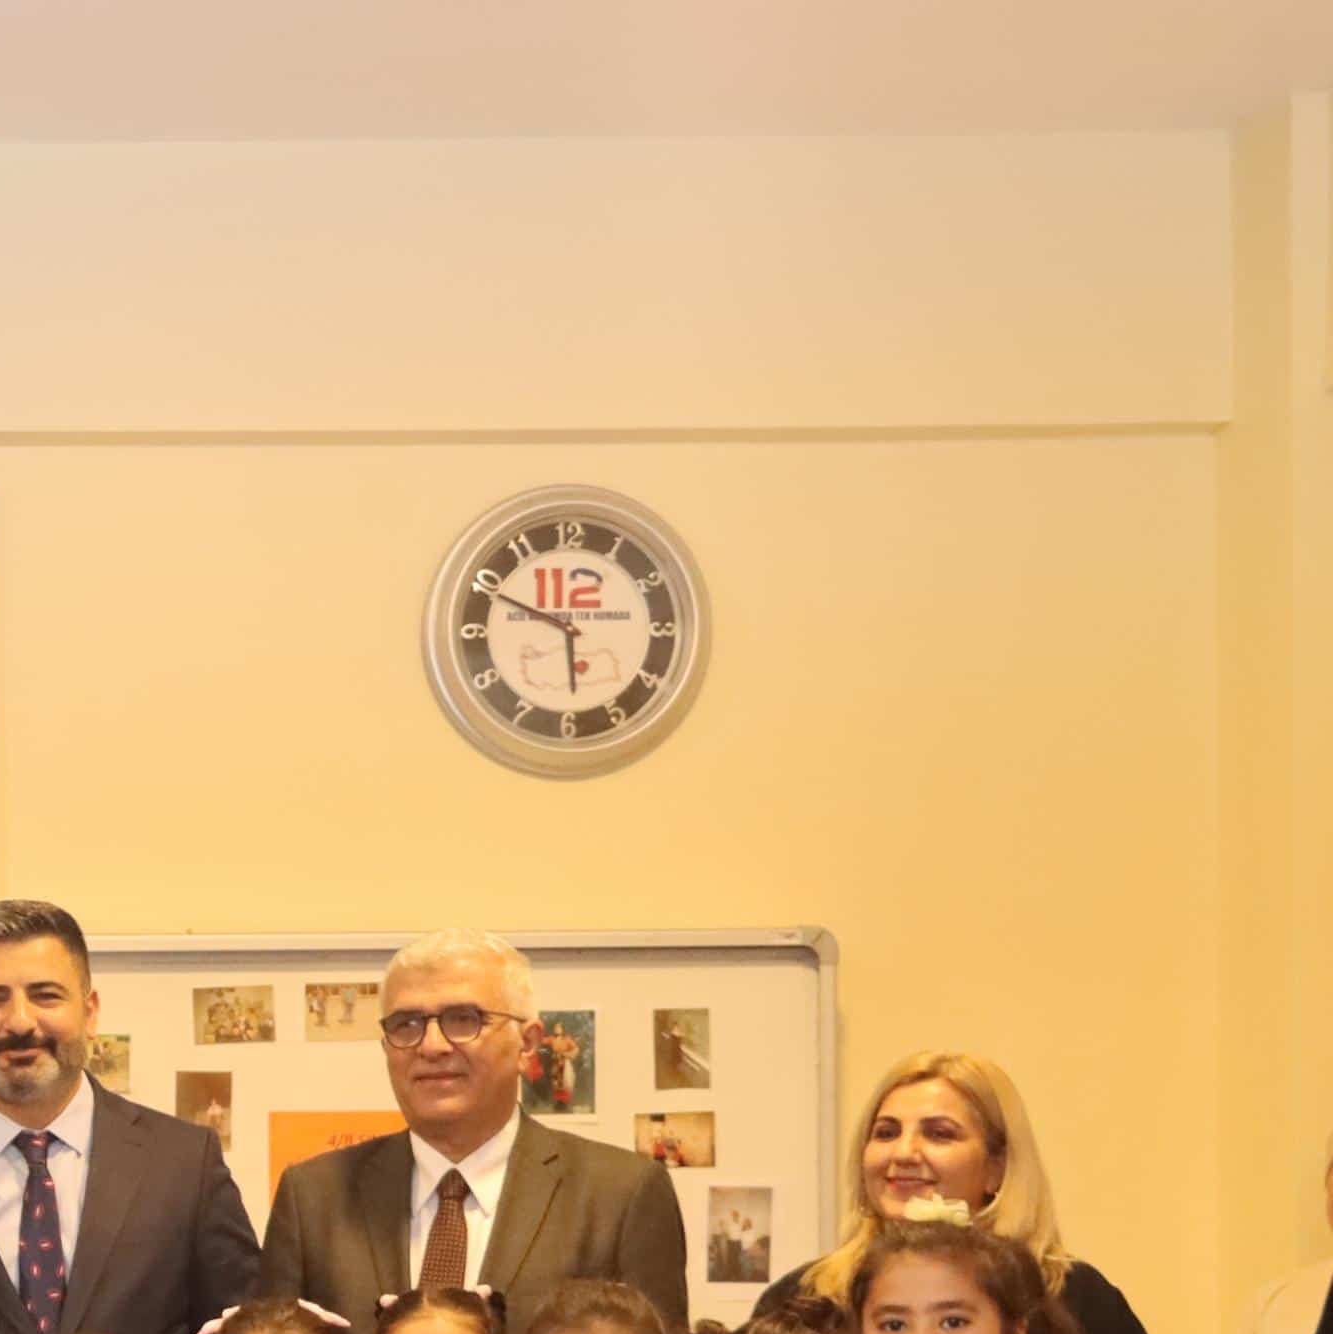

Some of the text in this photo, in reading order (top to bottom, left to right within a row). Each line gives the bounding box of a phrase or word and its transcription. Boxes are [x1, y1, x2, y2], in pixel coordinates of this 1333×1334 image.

[554, 521, 585, 548] 12
[507, 534, 537, 562] 11
[605, 535, 625, 559] 1
[471, 567, 503, 596] 10
[534, 567, 603, 609] 112
[636, 570, 662, 594] 2
[460, 622, 487, 639] 9
[652, 621, 675, 638] 3
[472, 667, 499, 690] 8
[636, 669, 662, 690] 4
[511, 703, 534, 727] 7
[605, 699, 628, 726] 5
[559, 711, 577, 739] 6
